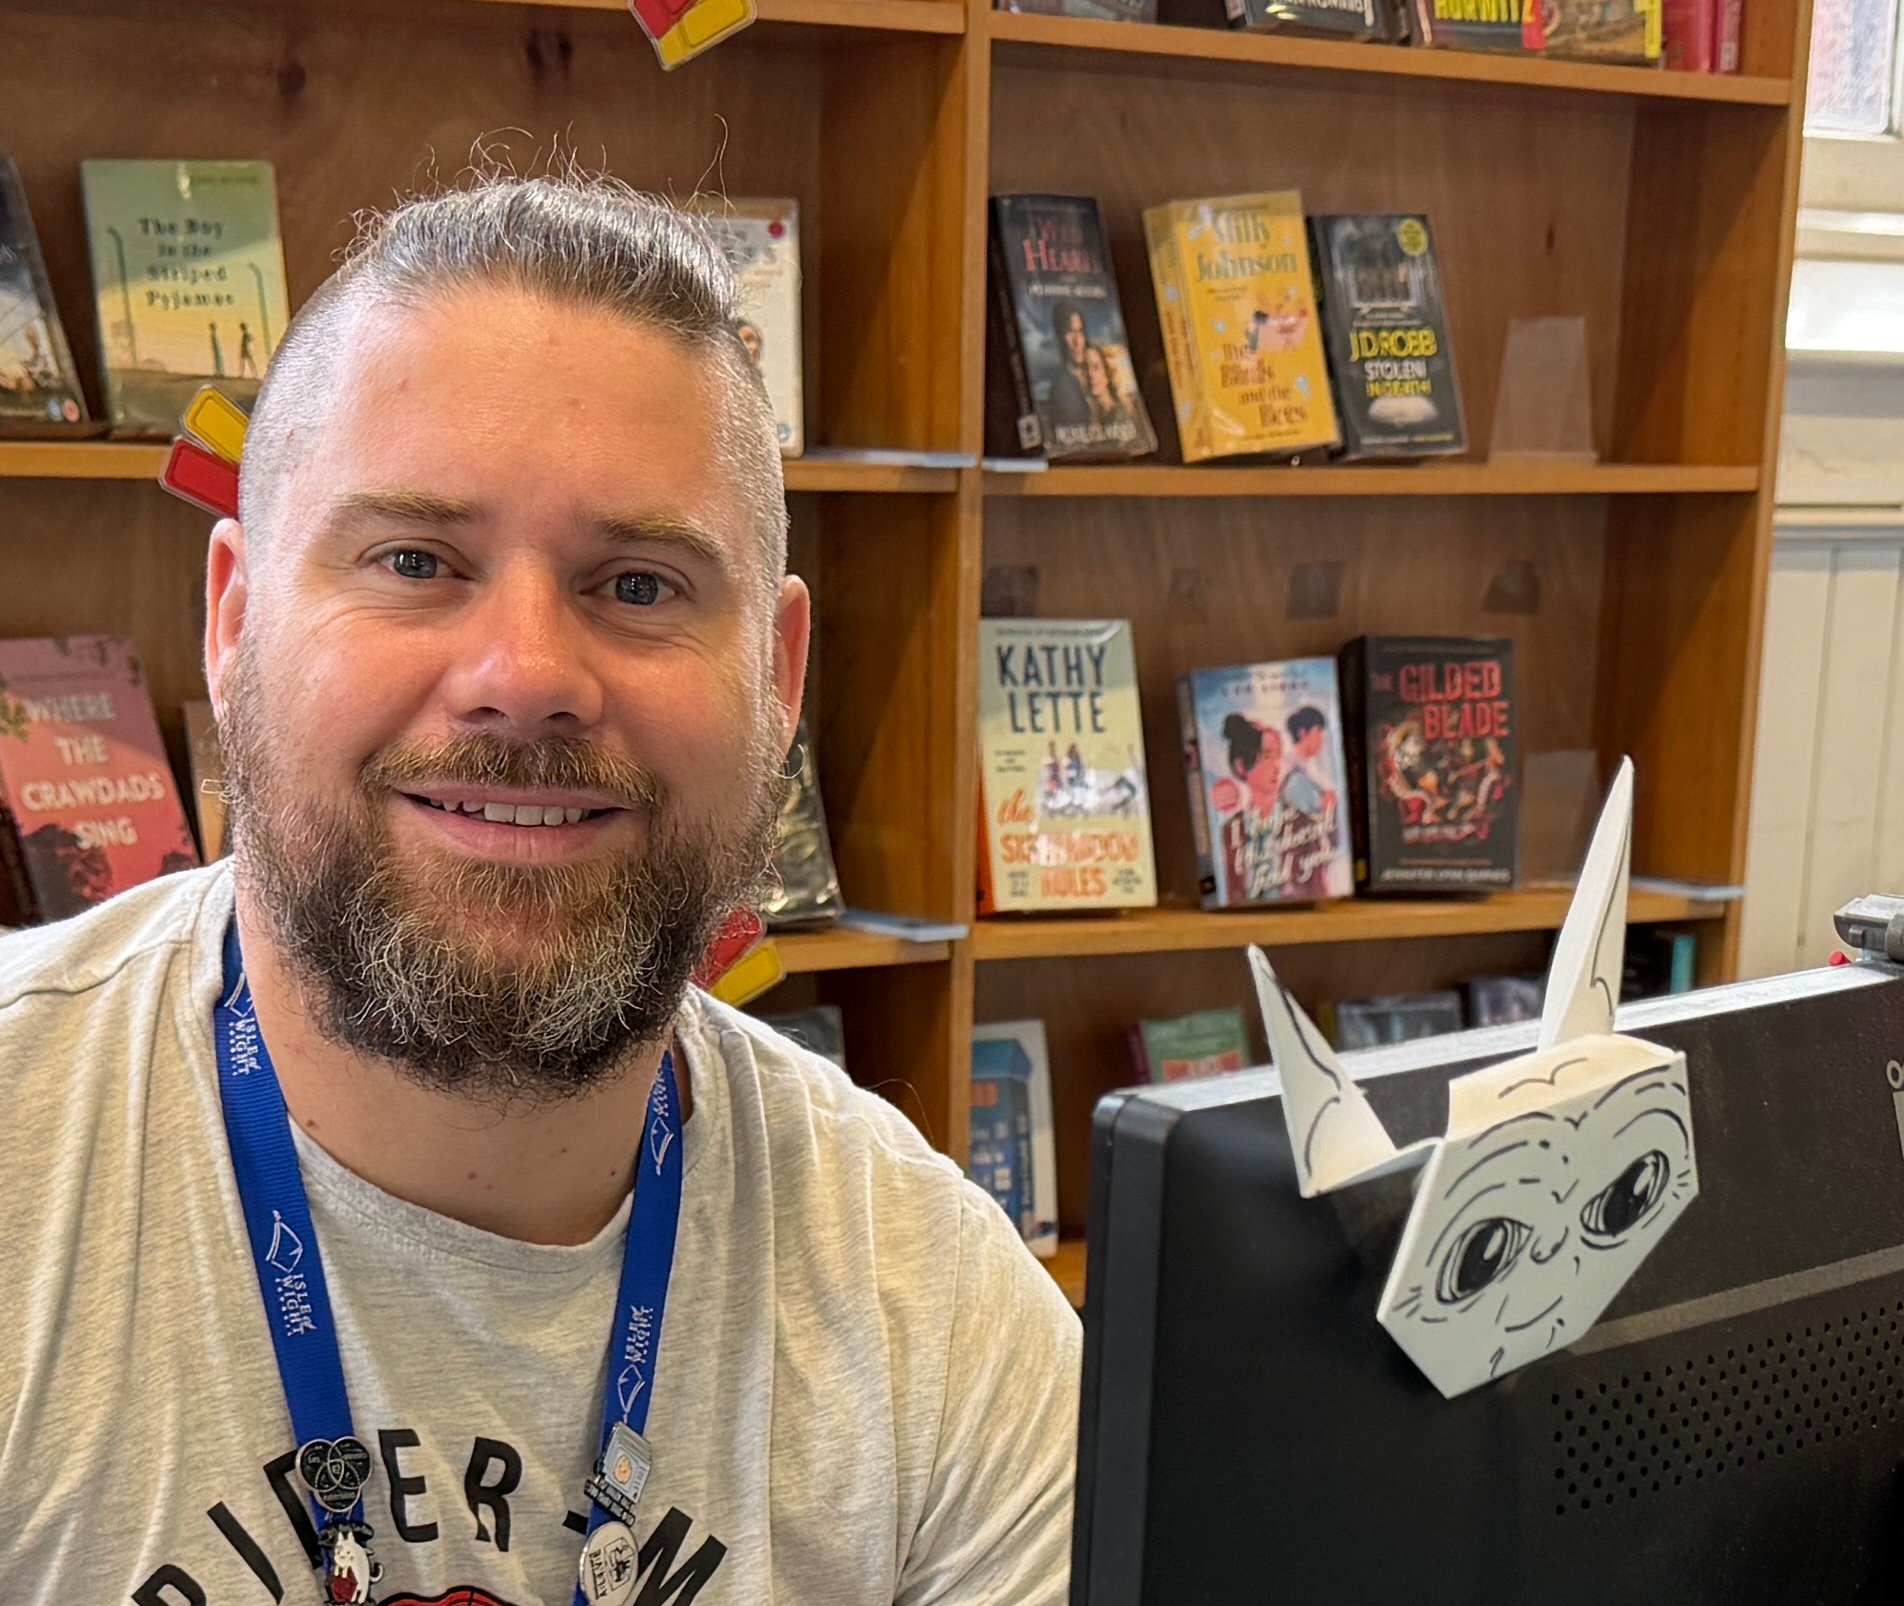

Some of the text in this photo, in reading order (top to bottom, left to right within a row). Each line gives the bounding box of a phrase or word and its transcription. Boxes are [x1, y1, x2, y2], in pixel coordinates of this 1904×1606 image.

[997, 645, 1106, 686] KATHY
[1399, 660, 1501, 701] GILDED
[24, 694, 116, 721] WHERE
[1008, 690, 1107, 734] LETTE
[1422, 700, 1510, 740] BLADE
[55, 737, 108, 764] THE
[74, 818, 137, 850] SING
